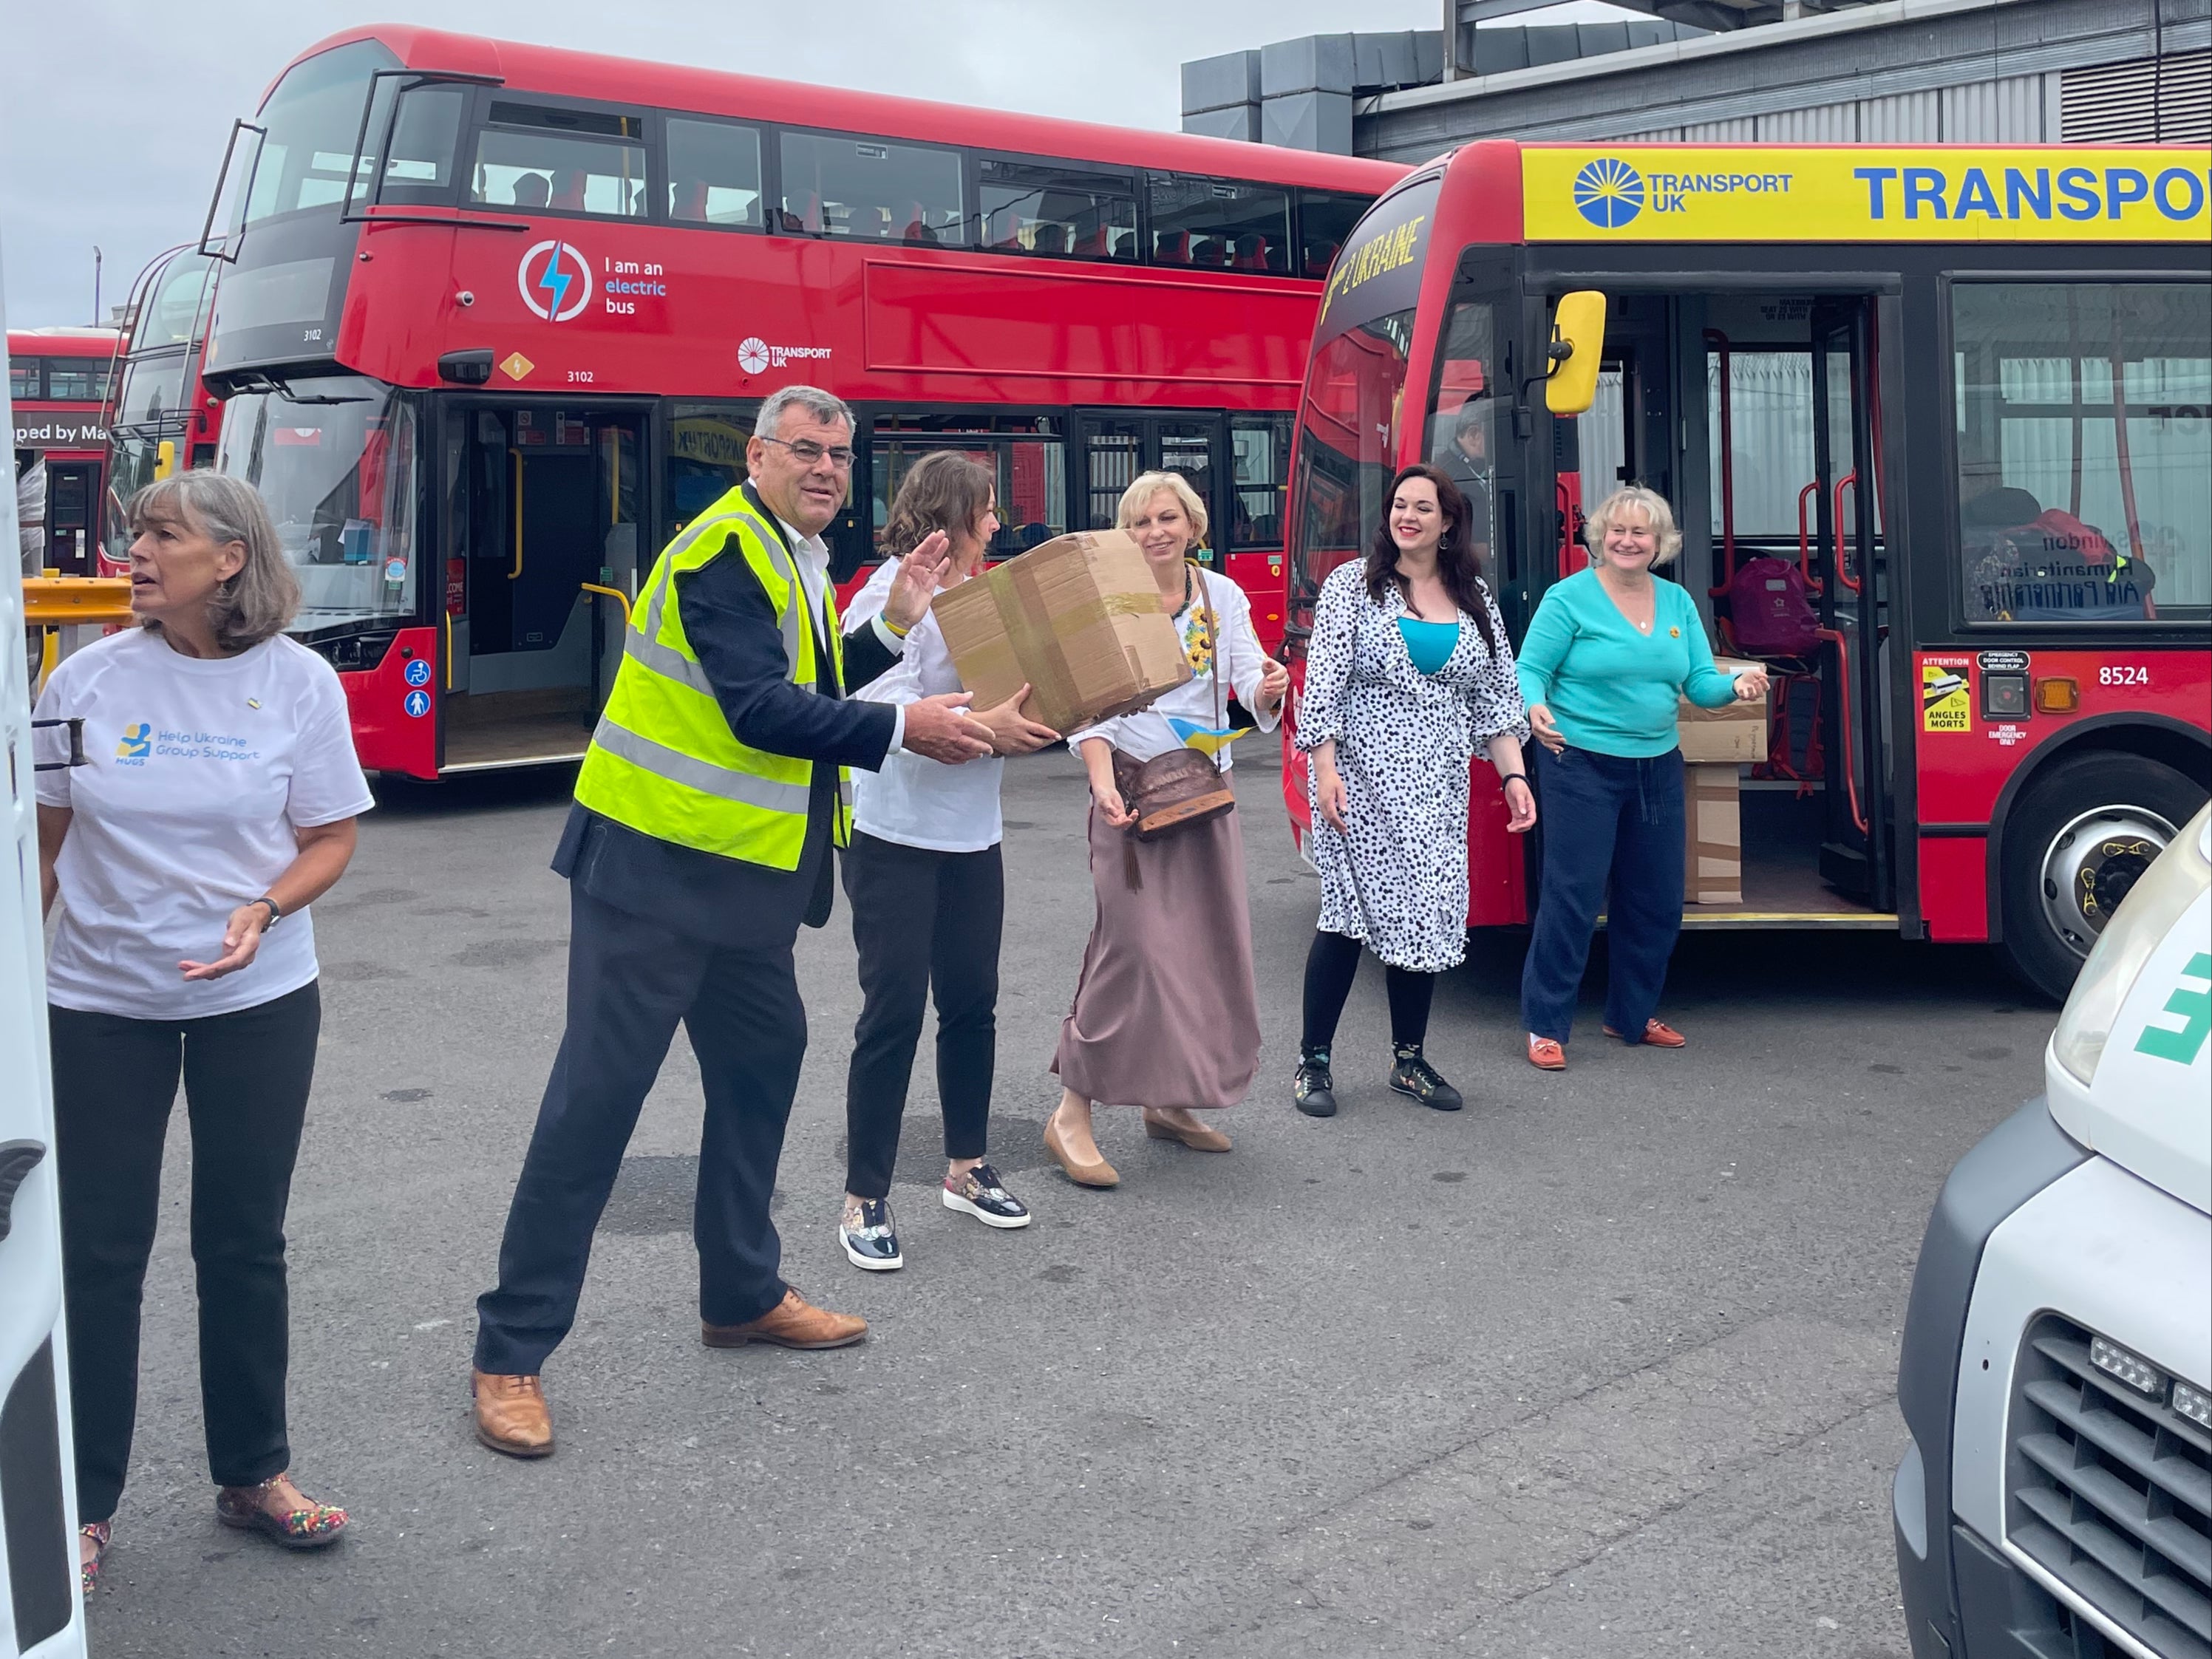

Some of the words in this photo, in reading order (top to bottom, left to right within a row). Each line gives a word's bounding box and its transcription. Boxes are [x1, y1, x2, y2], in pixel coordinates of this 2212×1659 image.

[1647, 174, 1793, 192] TRANSPORT
[1854, 167, 2211, 220] TRANSPO
[1653, 194, 1687, 212] UK
[1352, 215, 1425, 288] UKRAINE
[605, 256, 610, 273] I
[615, 261, 639, 274] am
[644, 263, 663, 276] an
[605, 278, 666, 296] electric
[606, 297, 635, 314] bus
[303, 328, 321, 341] 3102
[770, 346, 831, 359] TRANSPORT
[772, 357, 788, 367] UK
[567, 371, 593, 383] 3102
[13, 423, 51, 443] ped
[55, 424, 77, 443] by
[2099, 667, 2148, 685] 8524
[1929, 711, 1966, 719] ANGLES
[1931, 720, 1964, 728] MORTS
[157, 730, 191, 744] Help
[194, 732, 247, 747] Ukraine
[1988, 731, 2026, 739] EMERGENCY
[156, 744, 200, 759] Group
[203, 746, 261, 761] Support
[115, 757, 146, 766] HUGS
